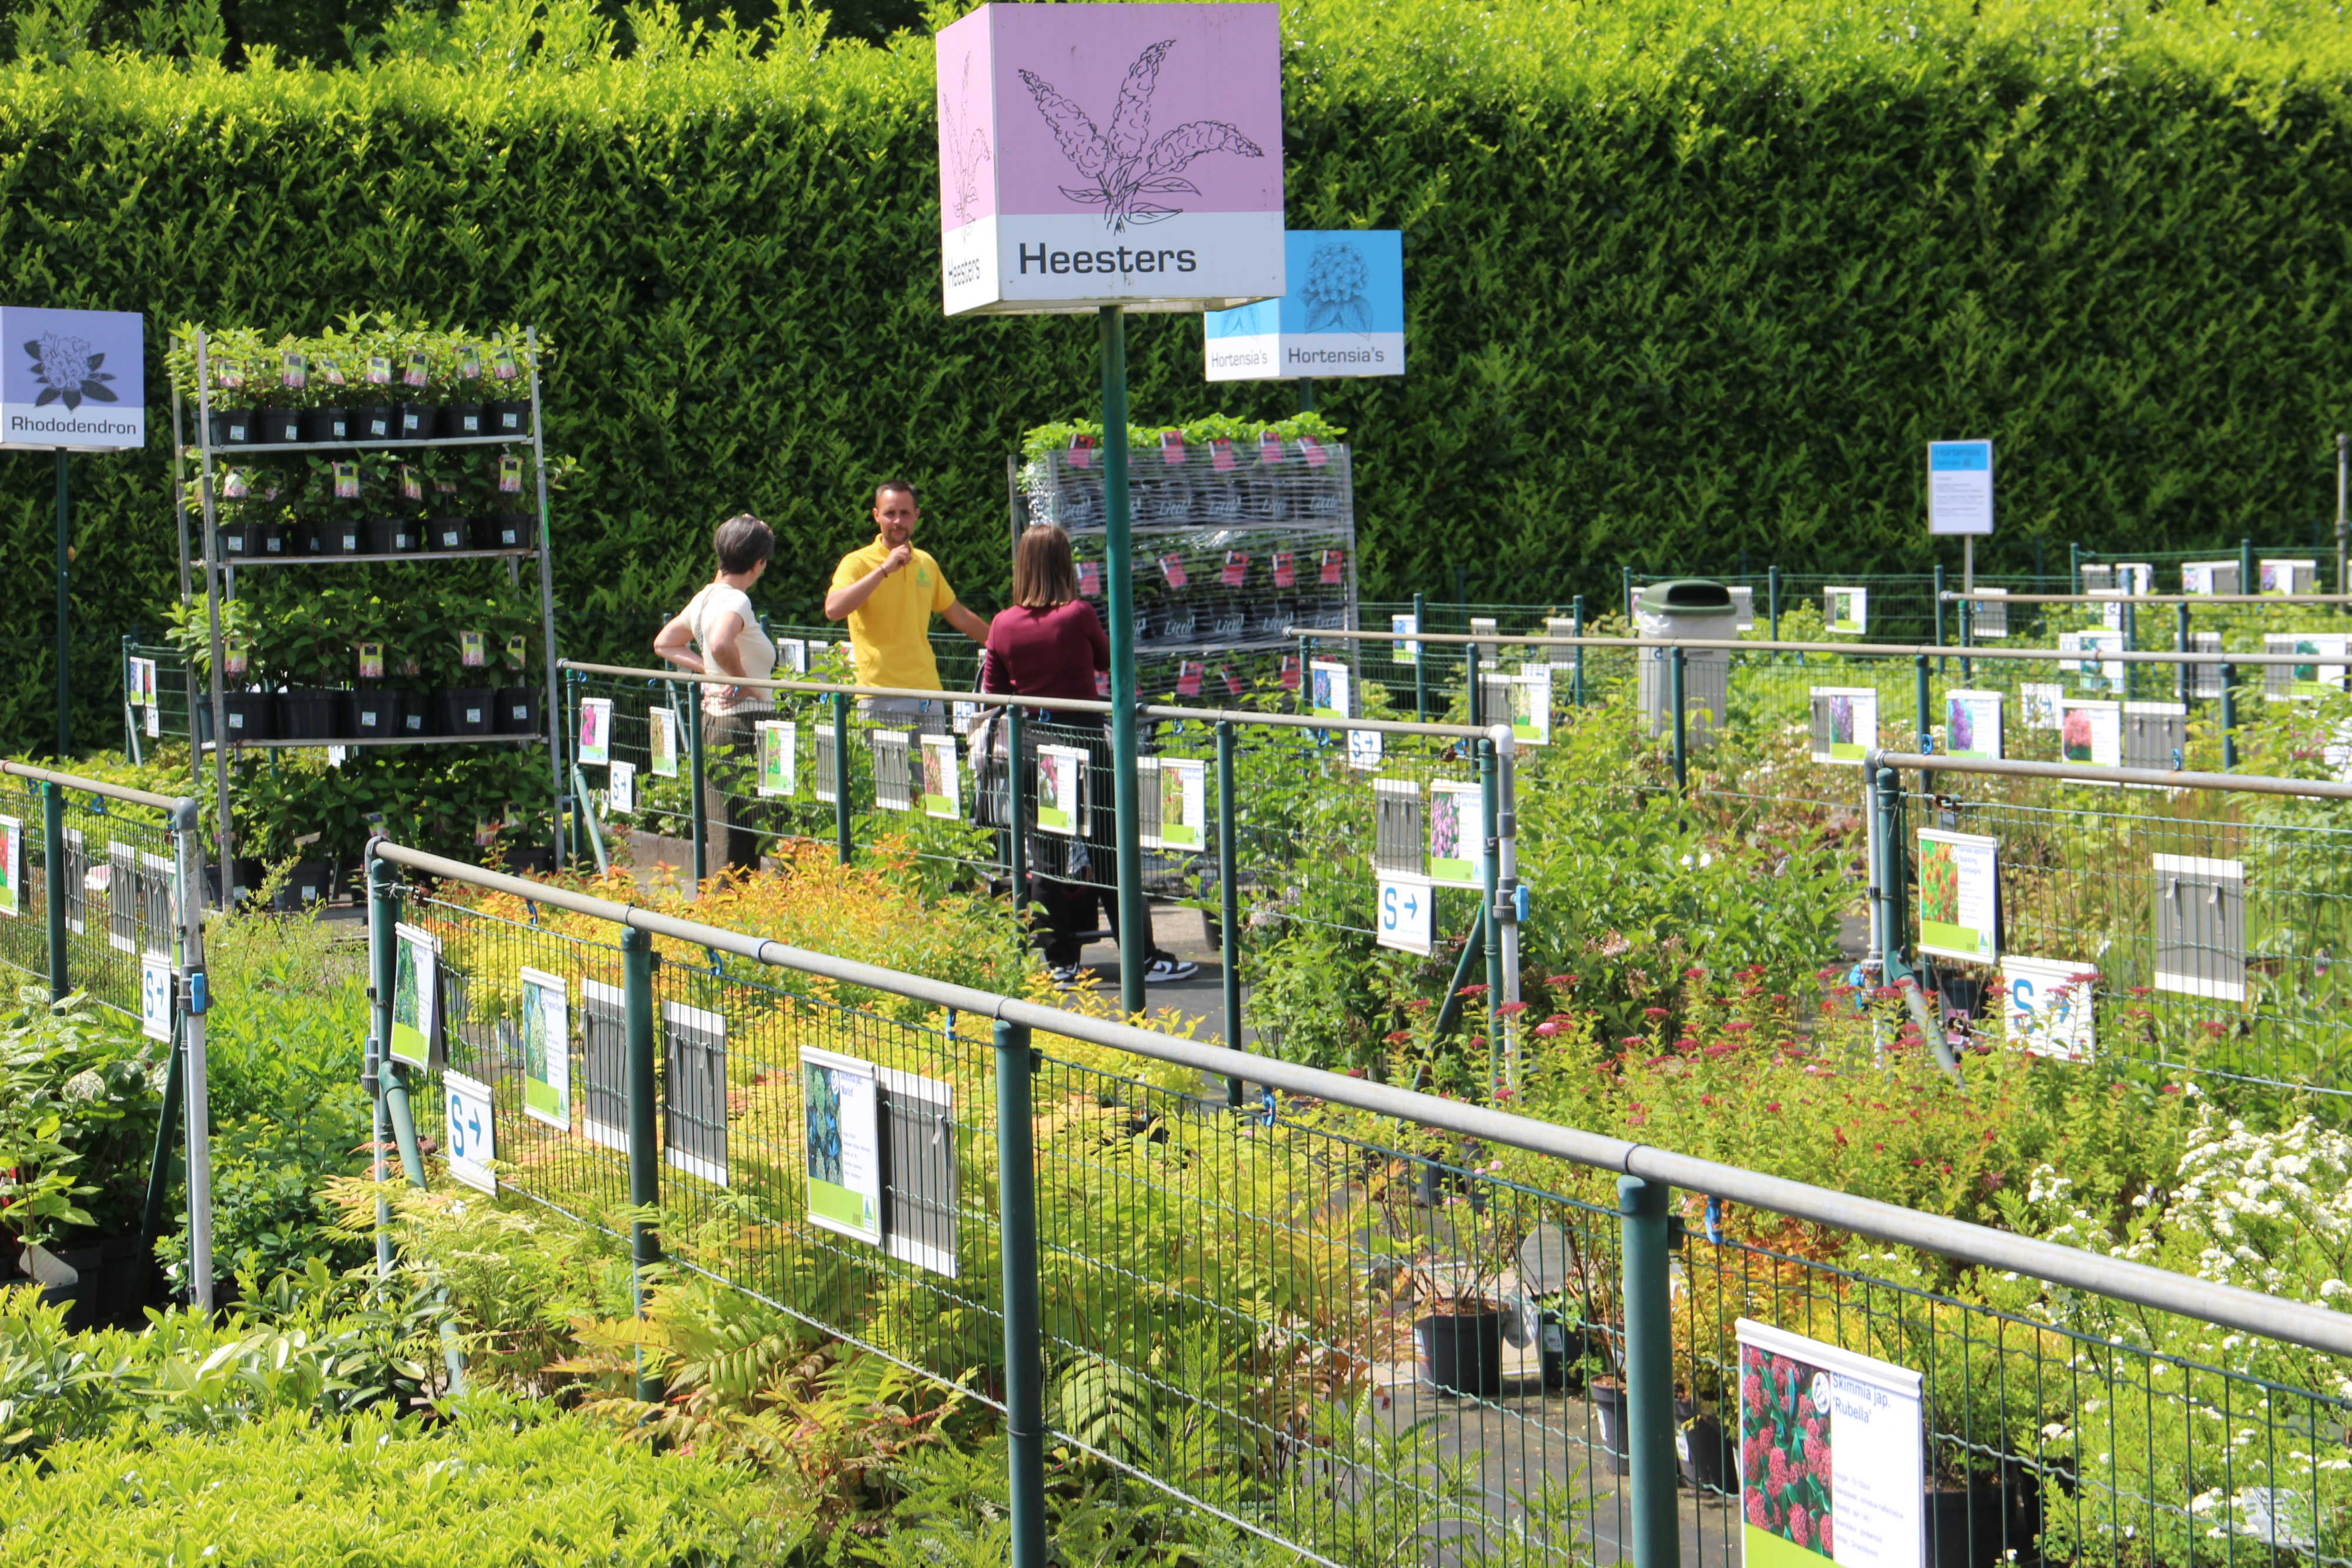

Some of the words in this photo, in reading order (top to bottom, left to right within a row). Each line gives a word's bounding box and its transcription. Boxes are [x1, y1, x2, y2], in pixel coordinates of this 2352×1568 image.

[947, 258, 981, 290] Heesters
[1019, 242, 1197, 275] Heesters
[1211, 349, 1268, 368] Hortensia's
[1288, 346, 1384, 363] Hortensia's
[11, 416, 136, 434] Rhododendron
[1352, 730, 1361, 758] S
[613, 772, 619, 800] S
[1384, 887, 1397, 930] S
[146, 970, 153, 1018] S
[2013, 978, 2035, 1035] S
[451, 1094, 465, 1158] S
[1832, 1373, 1872, 1400] Skimmia
[1873, 1387, 1891, 1410] jap.
[1833, 1396, 1872, 1423] 'Rubella'
